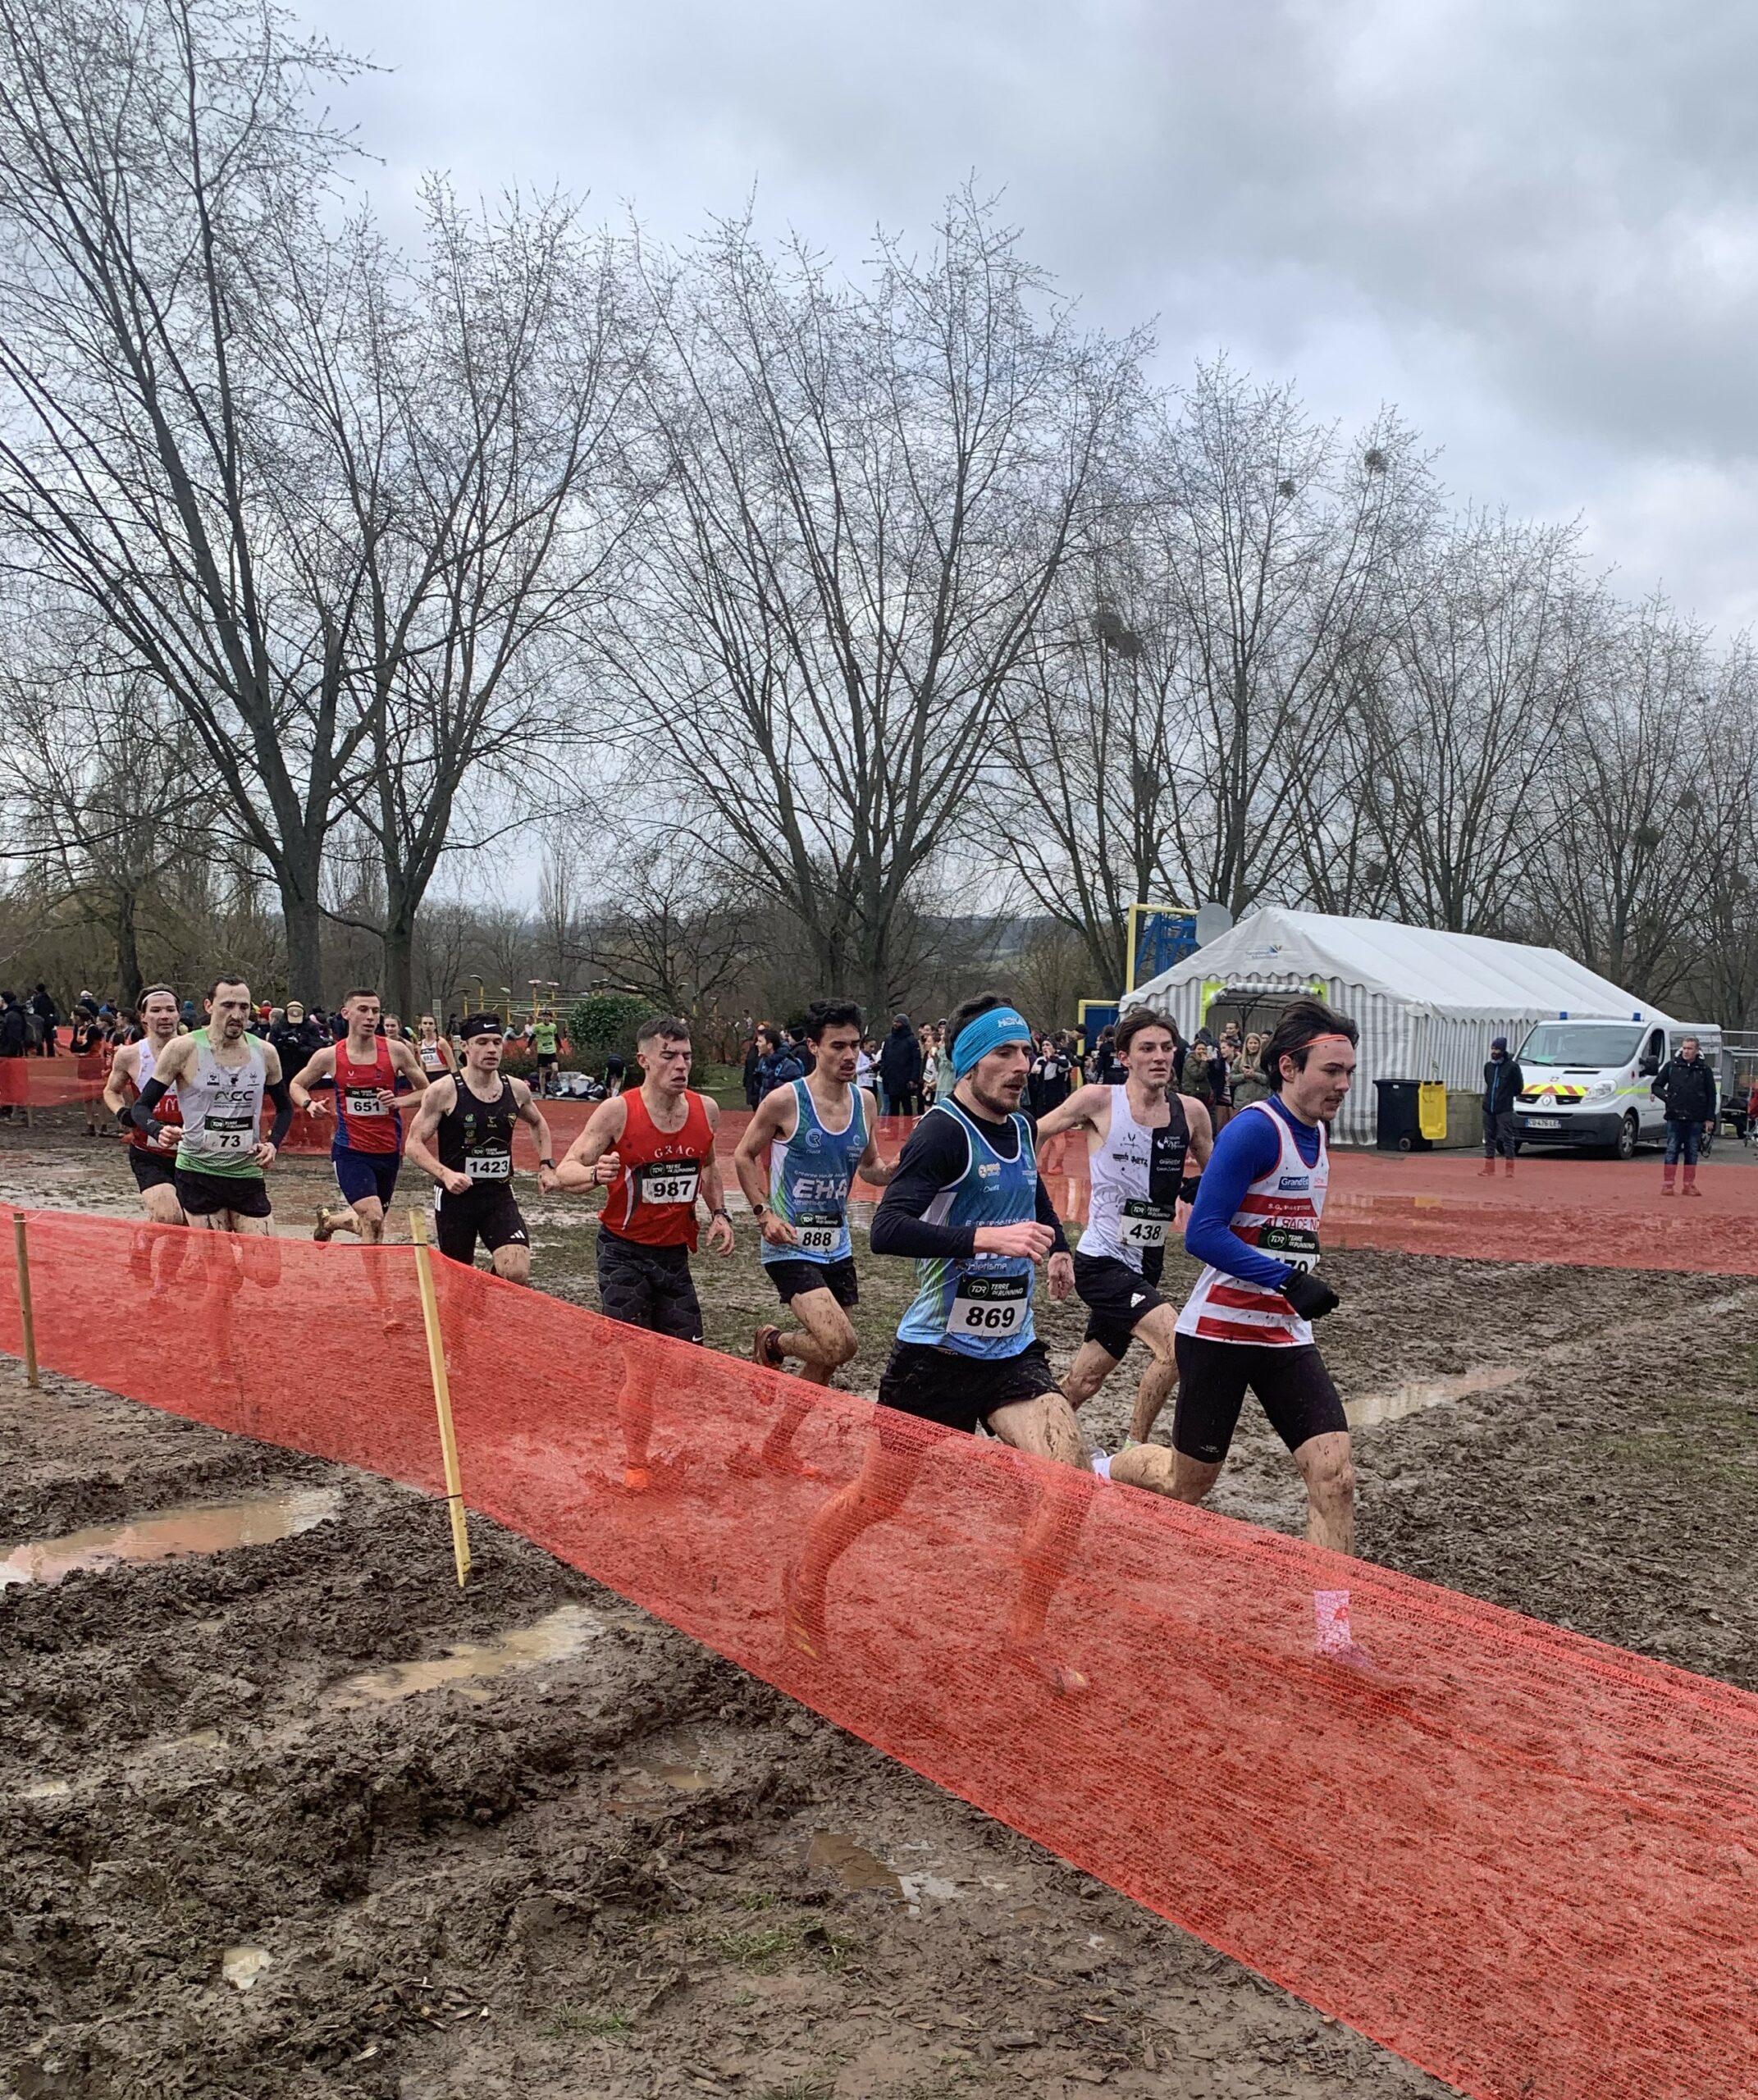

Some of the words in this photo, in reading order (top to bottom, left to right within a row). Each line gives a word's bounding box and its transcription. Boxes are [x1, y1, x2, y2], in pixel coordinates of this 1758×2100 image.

[354, 1101, 380, 1112] 651
[219, 1135, 240, 1148] 73
[654, 1144, 695, 1158] GRAC
[469, 1160, 508, 1173] 1423
[653, 1180, 692, 1198] 987
[792, 1177, 847, 1199] EHA
[1130, 1224, 1162, 1240] 438
[802, 1231, 832, 1247] 888
[1270, 1235, 1285, 1244] TDR
[971, 1285, 987, 1294] TDR
[998, 1287, 1024, 1297] RUNNING
[966, 1306, 1016, 1329] 869
